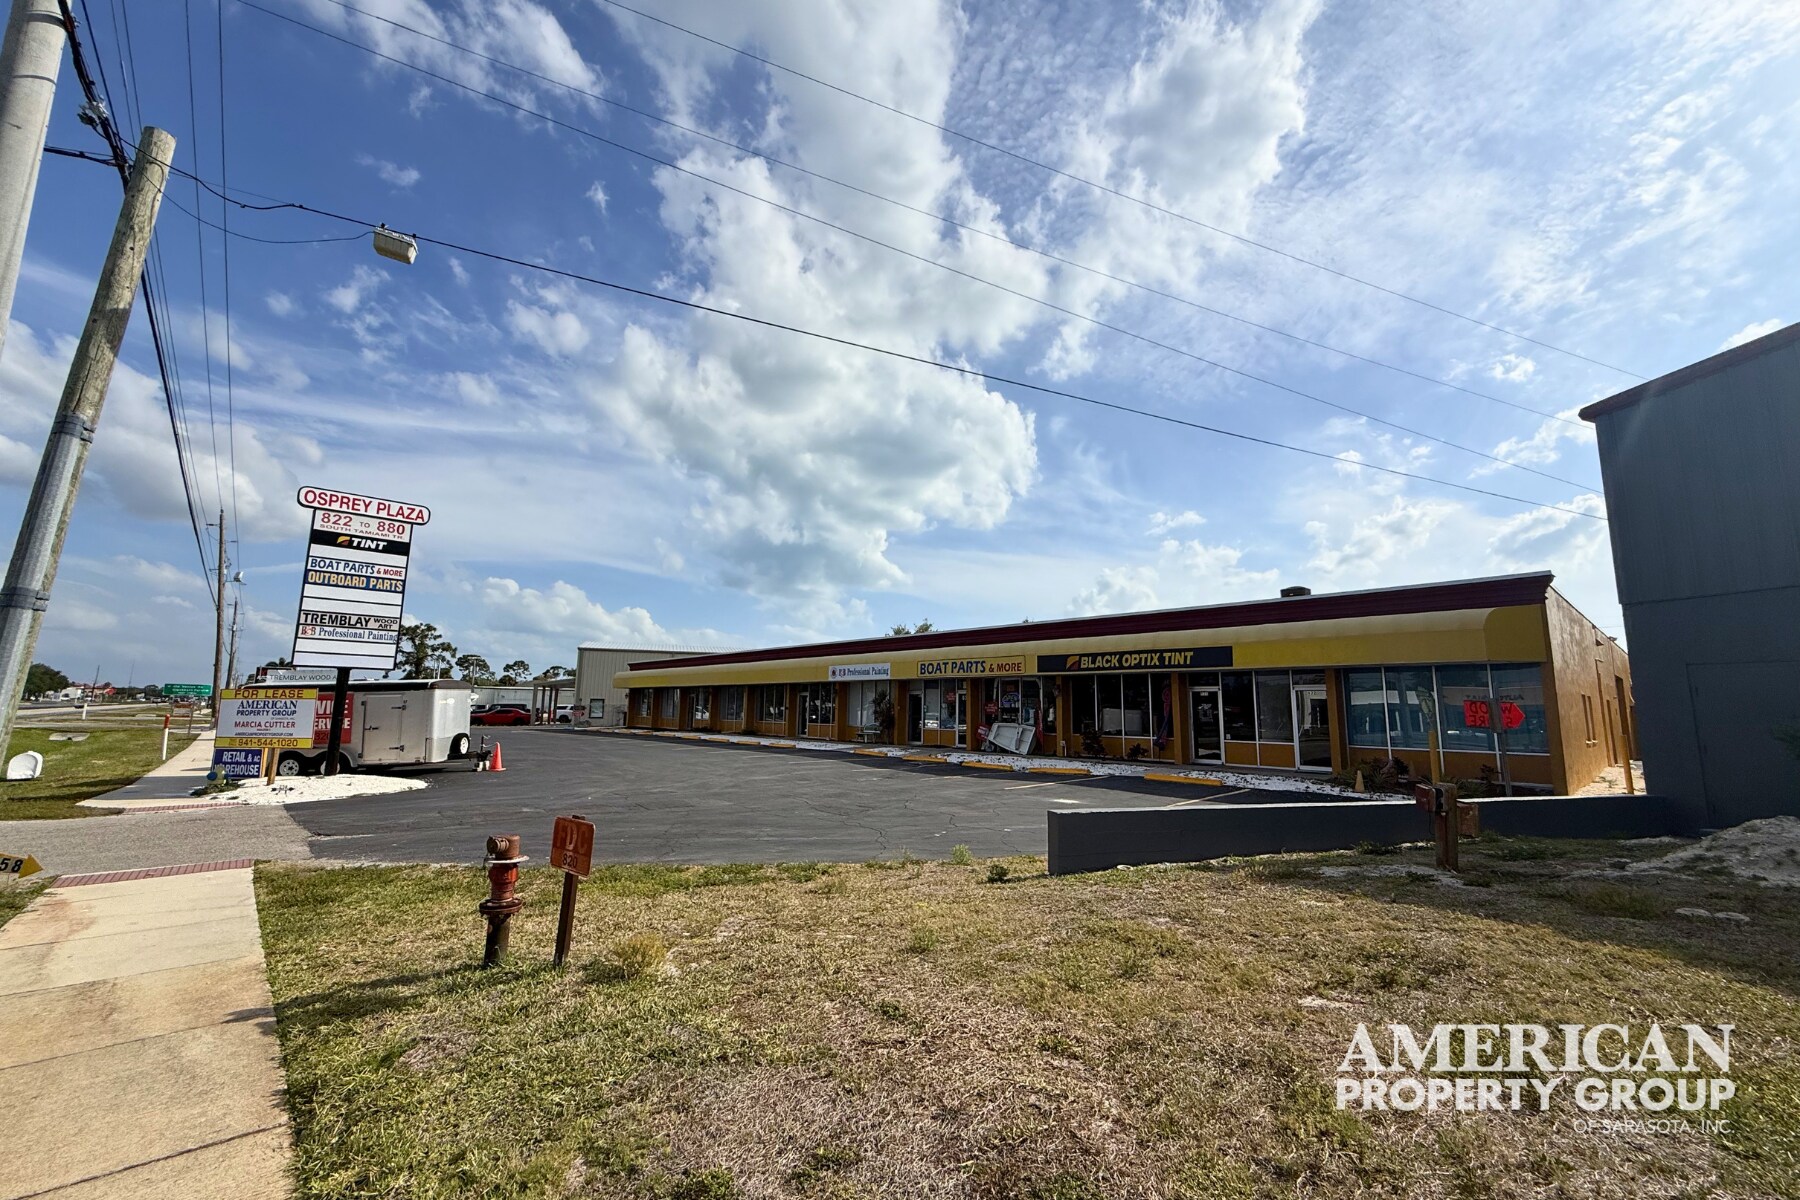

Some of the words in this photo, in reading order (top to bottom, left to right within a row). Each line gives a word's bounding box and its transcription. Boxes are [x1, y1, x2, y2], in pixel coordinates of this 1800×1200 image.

[304, 490, 372, 513] OSPREY
[376, 502, 425, 522] PLAZA
[320, 523, 351, 532] SOUTH
[354, 528, 390, 539] TAMIAMI
[321, 512, 353, 527] 822
[360, 521, 371, 529] TO
[377, 521, 405, 535] 880
[351, 538, 387, 550] TINT
[310, 558, 341, 570] BOAT
[343, 562, 375, 574] PARTS
[383, 568, 403, 577] MORE
[308, 571, 366, 588] OUTBOARD
[369, 578, 403, 591] PARTS
[303, 612, 371, 627] TREMBLAY
[318, 627, 366, 640] Professional
[367, 631, 398, 643] Painting
[1080, 655, 1119, 668] BLACK
[1122, 653, 1160, 667] OPTIX
[1163, 651, 1193, 665] TINT
[920, 662, 949, 674] BOAT
[951, 661, 986, 673] PARTS
[988, 664, 994, 673] &
[996, 662, 1022, 673] MORE
[234, 690, 259, 698] FOR
[265, 689, 304, 698] LEASE
[238, 700, 298, 709] AMERICAN
[238, 739, 298, 747] 941-544-1020
[222, 751, 246, 762] RETAIL
[247, 753, 252, 762] &
[562, 853, 578, 868] 820
